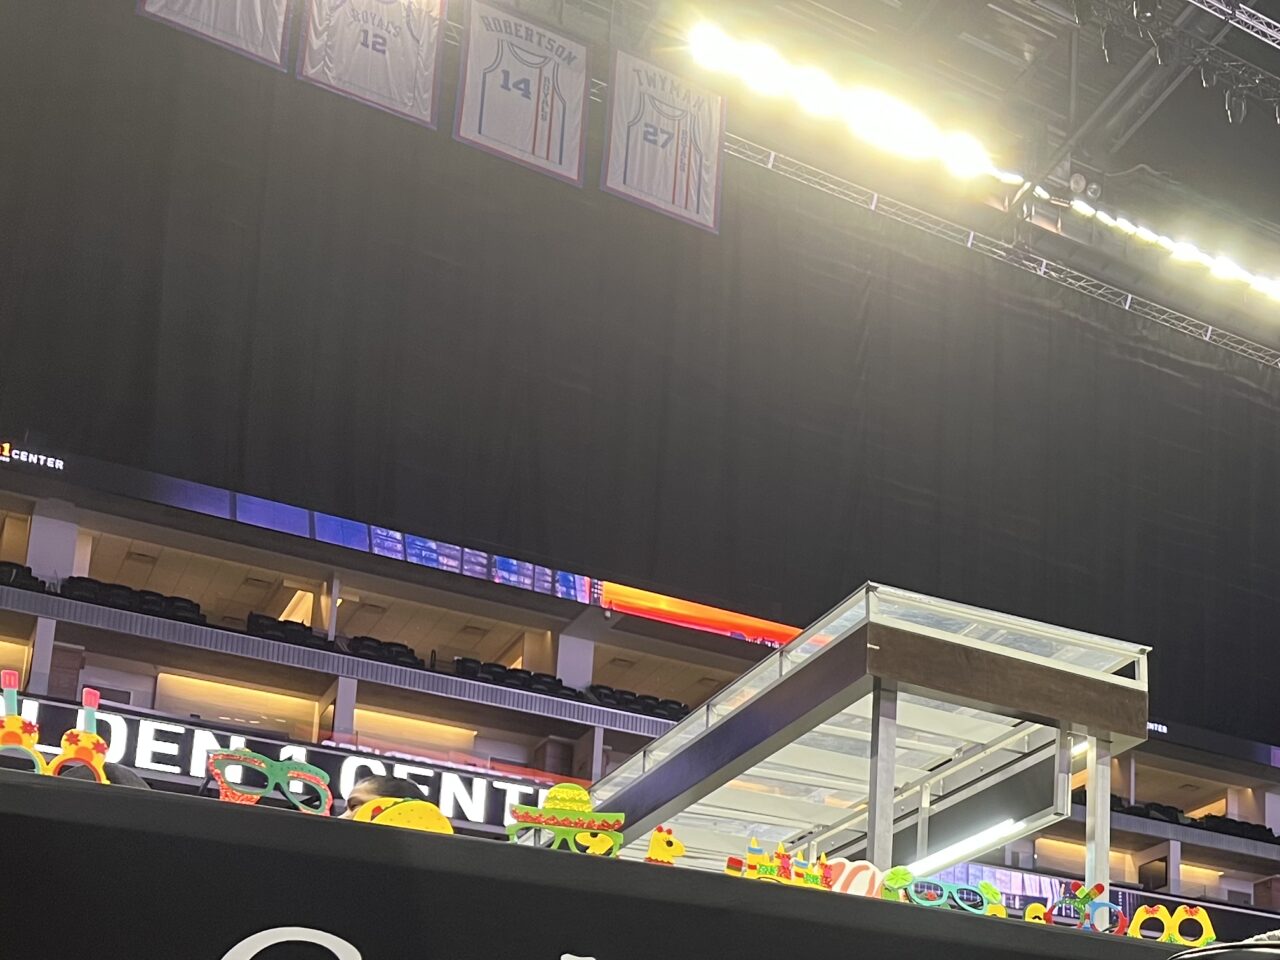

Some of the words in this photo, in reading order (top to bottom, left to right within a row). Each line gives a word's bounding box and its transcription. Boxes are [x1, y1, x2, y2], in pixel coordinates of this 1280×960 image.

[360, 28, 387, 55] 12
[480, 14, 578, 66] ROBERTSON
[500, 69, 532, 101] 14
[643, 122, 675, 150] 27
[11, 449, 65, 470] CENTER
